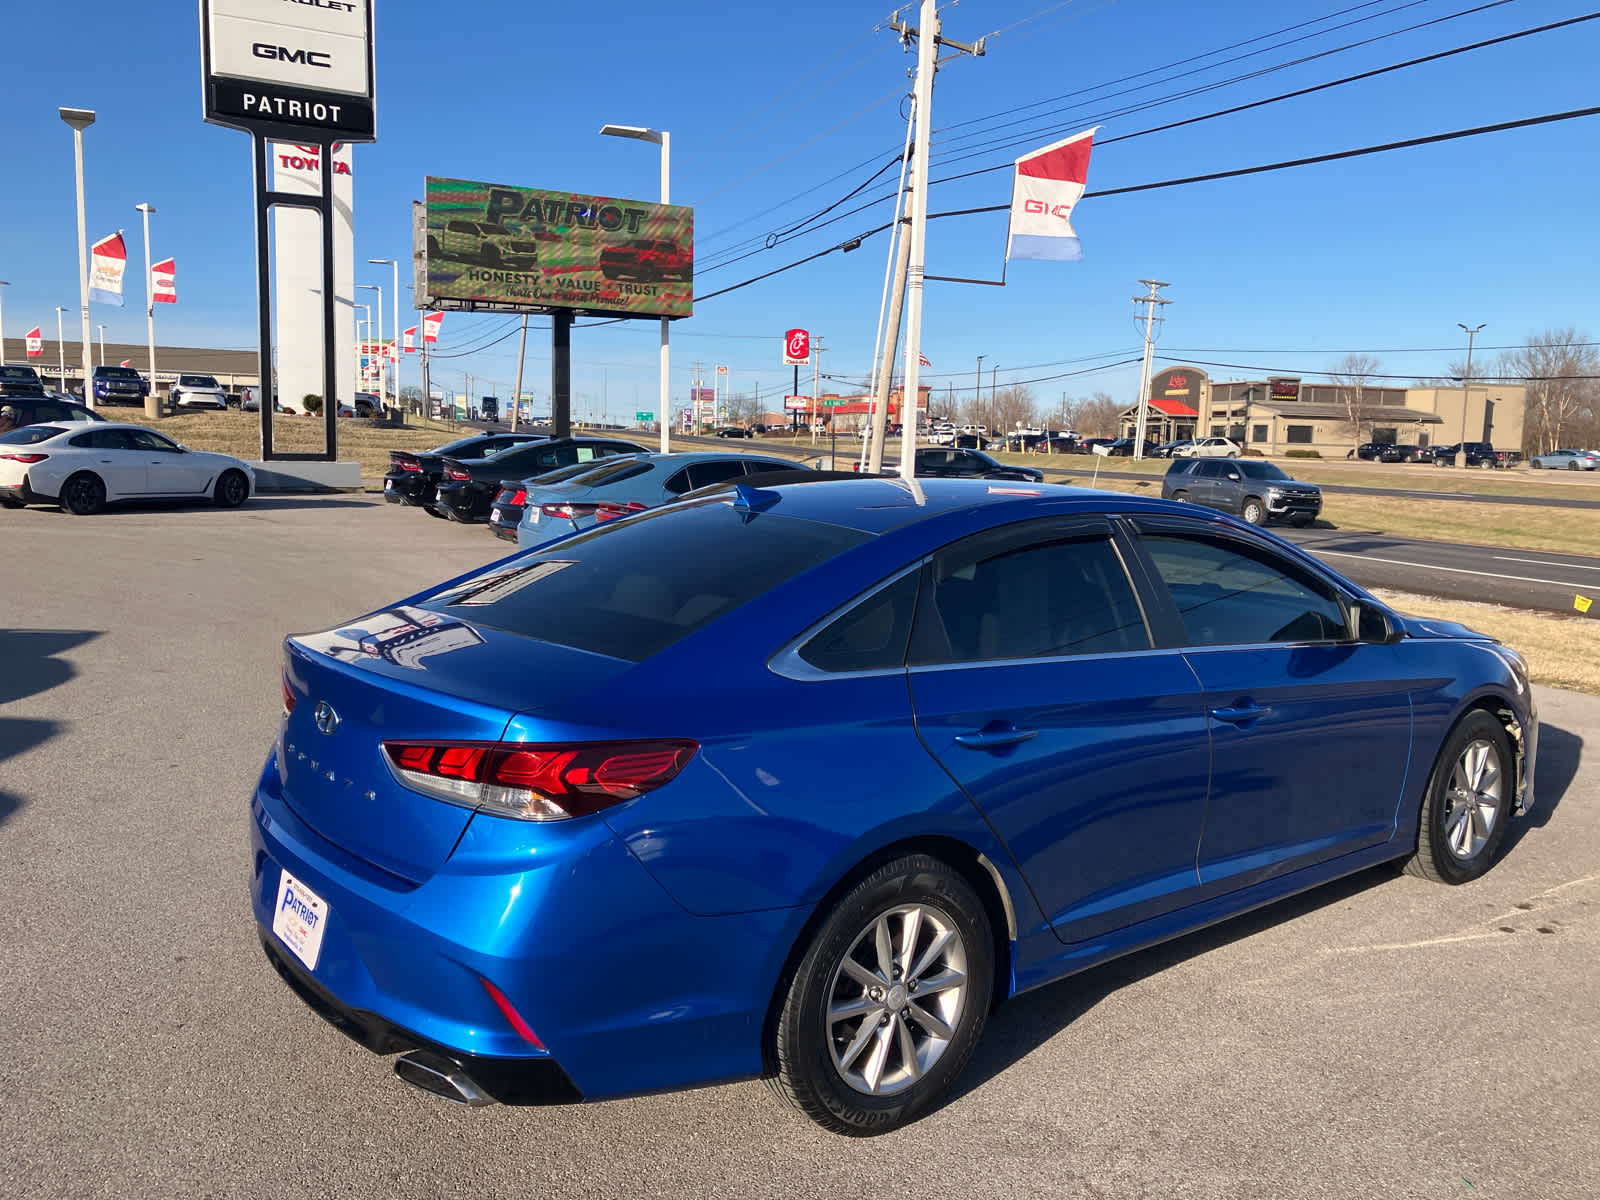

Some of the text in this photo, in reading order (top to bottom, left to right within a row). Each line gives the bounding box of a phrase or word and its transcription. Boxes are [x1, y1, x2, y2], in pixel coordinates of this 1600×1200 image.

[252, 42, 331, 68] GMC
[242, 93, 341, 122] PATRIOT
[485, 186, 647, 234] PATRIOT
[469, 270, 658, 297] HONESTY VALUE TRUST
[281, 887, 319, 929] PATRIOT
